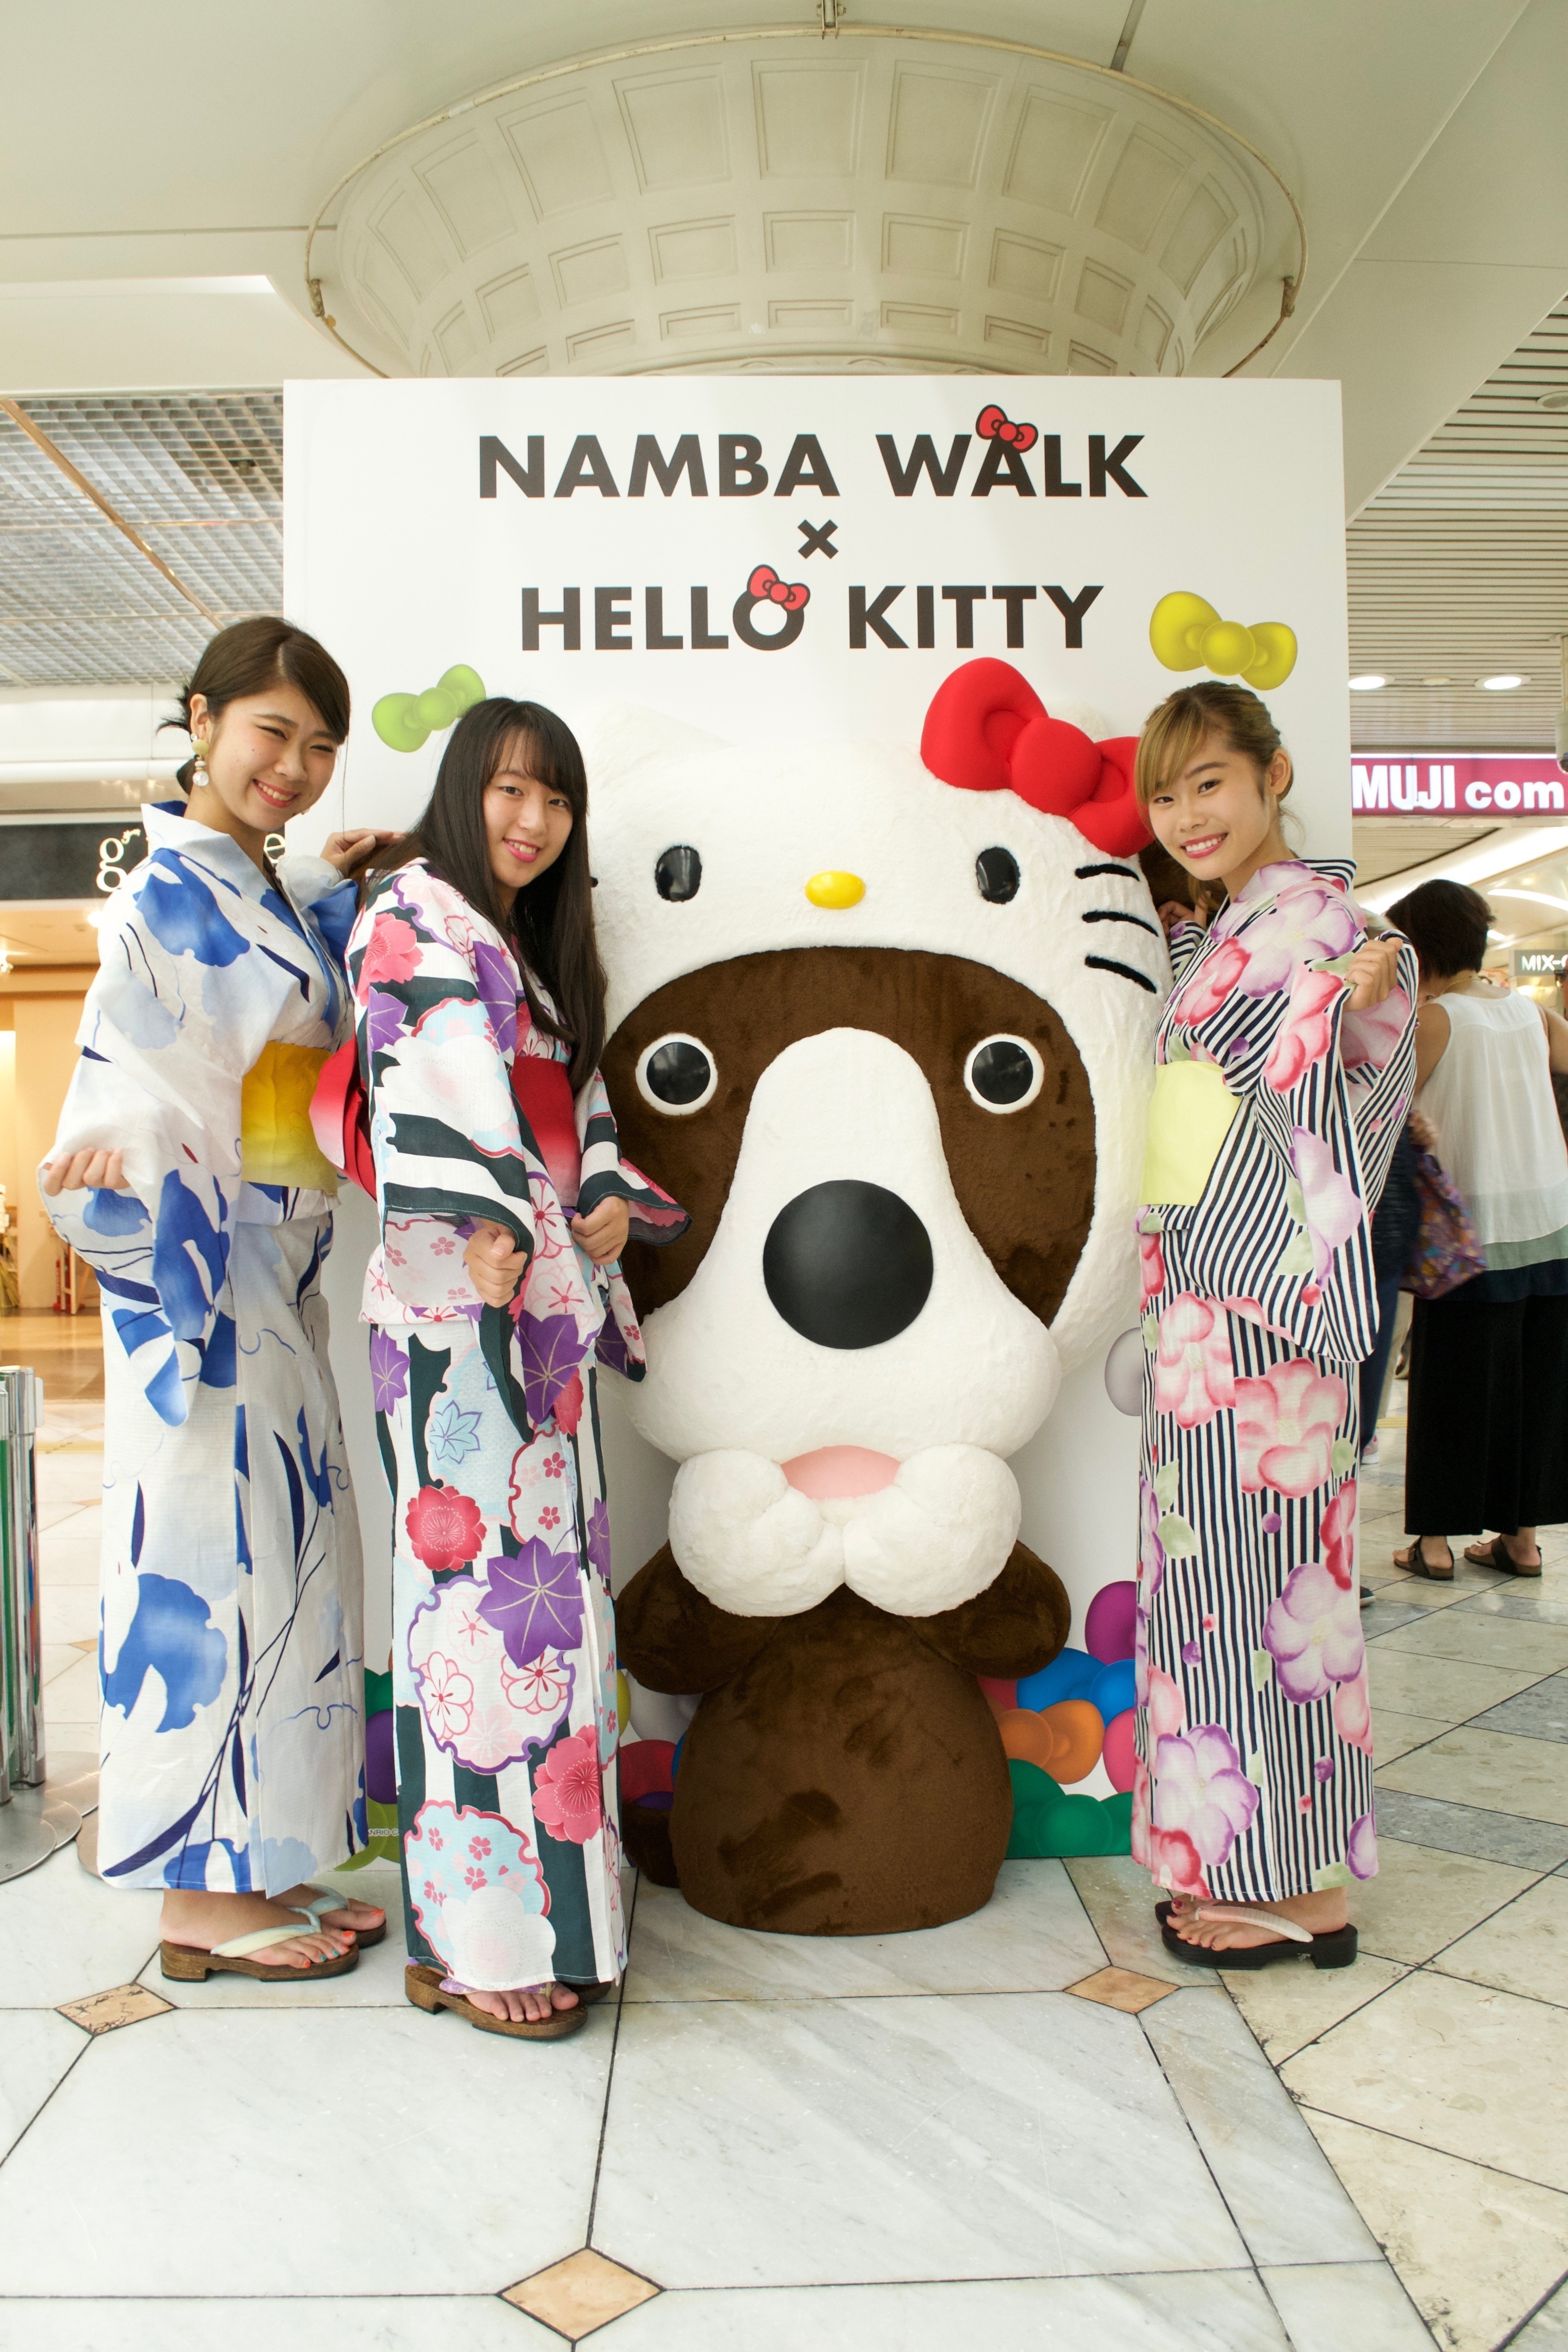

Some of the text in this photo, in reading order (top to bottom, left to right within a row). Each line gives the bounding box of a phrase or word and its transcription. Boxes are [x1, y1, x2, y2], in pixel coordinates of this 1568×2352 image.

[479, 434, 1148, 499] NAMBA WALK
[521, 585, 1105, 651] HELLO KITTY
[1352, 765, 1565, 811] MUJI com
